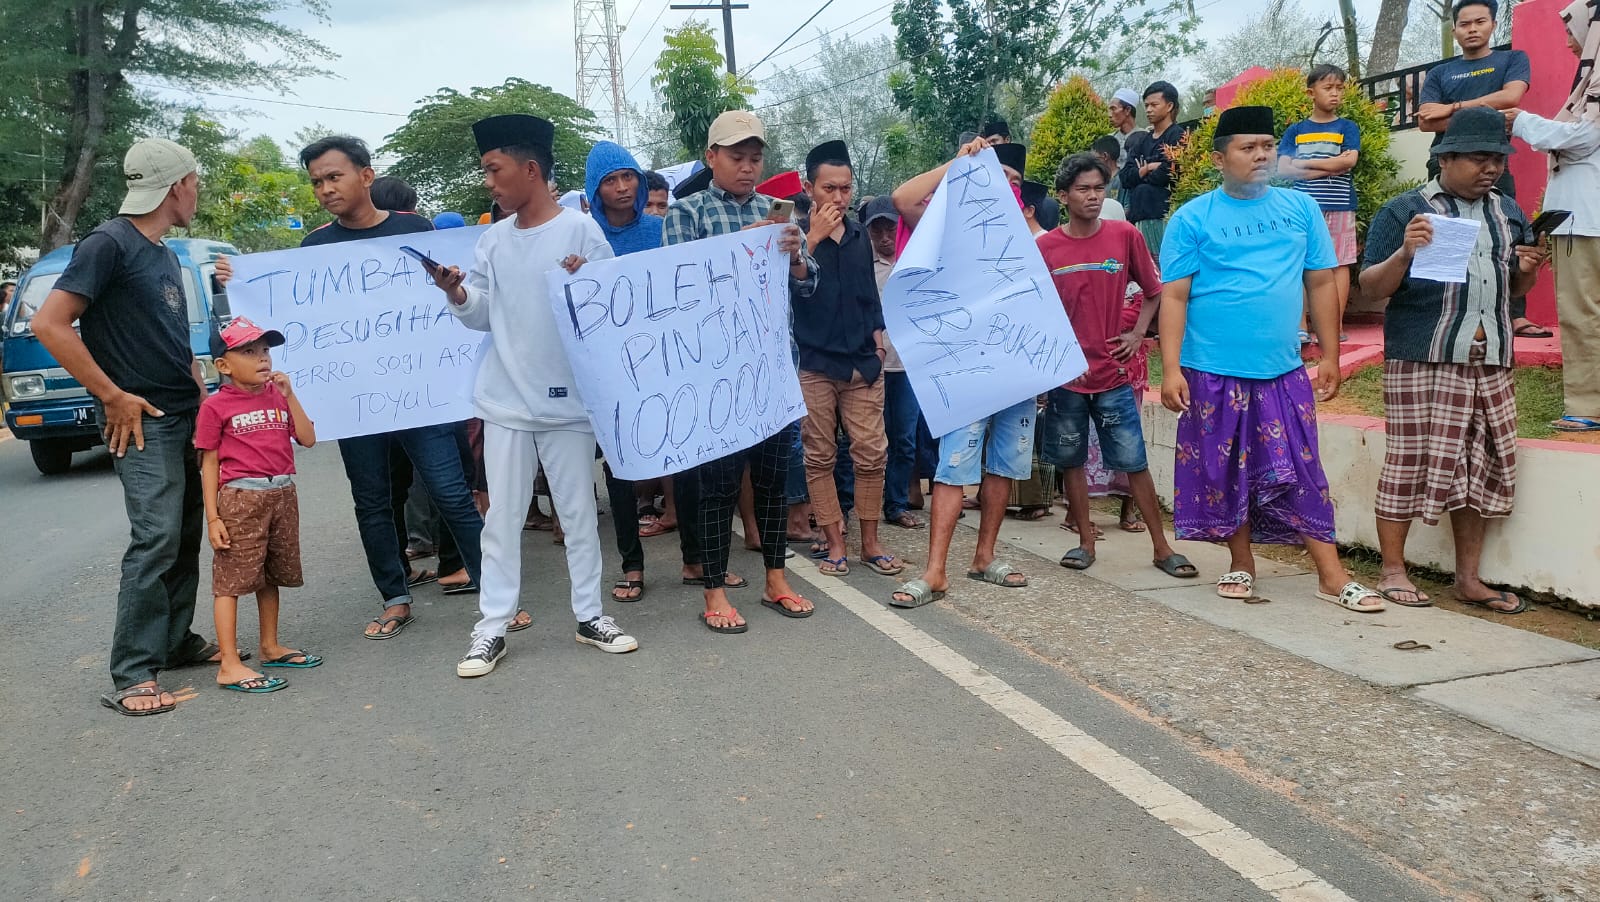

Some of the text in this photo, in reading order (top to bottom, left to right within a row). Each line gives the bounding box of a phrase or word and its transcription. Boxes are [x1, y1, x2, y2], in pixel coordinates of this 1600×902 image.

[1221, 217, 1292, 238] VOLCOM
[564, 249, 740, 342] BOLEH
[281, 303, 454, 361] PESUGIHA
[438, 343, 481, 367] AR
[898, 256, 995, 412] MBAL
[984, 312, 1073, 376] BUKAN
[231, 409, 266, 429] FREE
[266, 407, 289, 423] FIR
[663, 451, 689, 471] AH
[696, 440, 715, 460] AH
[720, 433, 740, 452] AH
